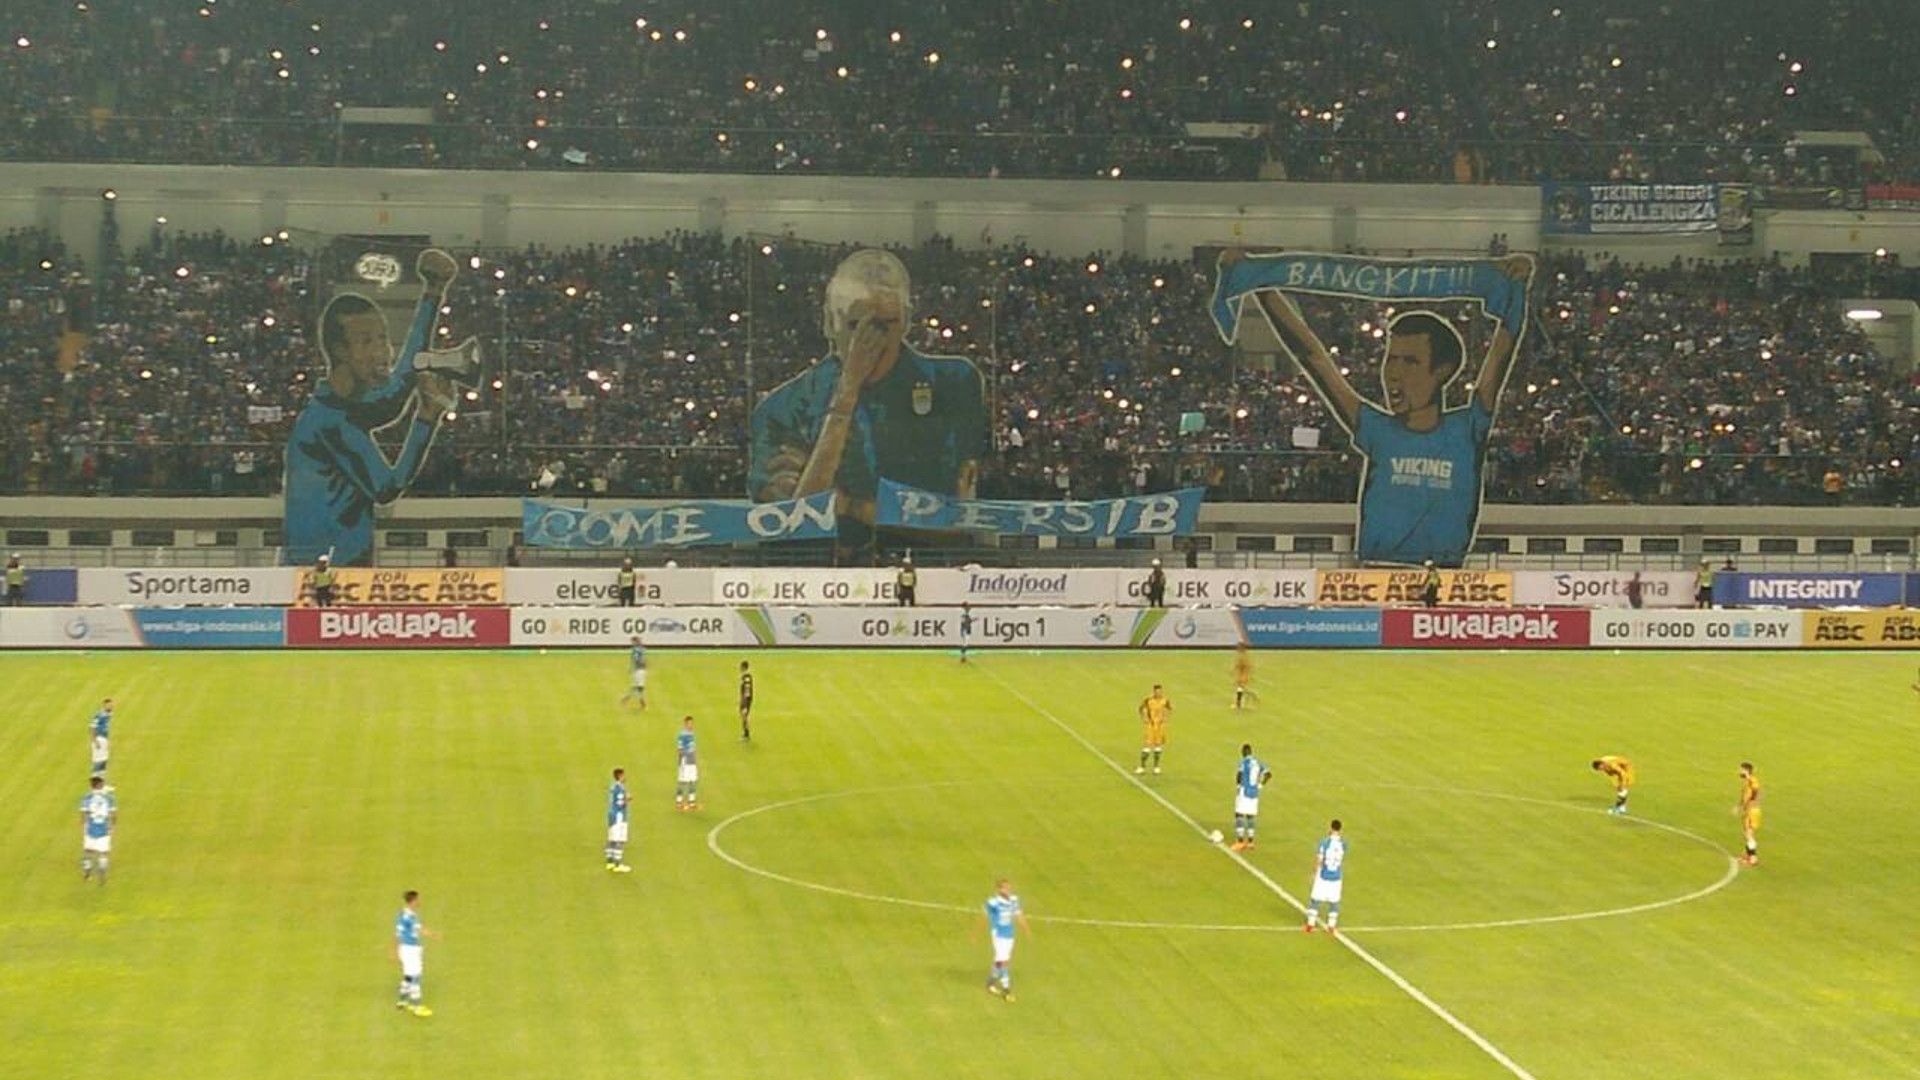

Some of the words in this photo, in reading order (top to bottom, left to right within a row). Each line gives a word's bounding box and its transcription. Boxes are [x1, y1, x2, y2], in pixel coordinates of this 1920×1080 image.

[1391, 458, 1453, 478] VIKING
[534, 509, 711, 547] COME
[748, 493, 836, 536] ON
[897, 490, 1179, 534] PERSIB
[126, 572, 250, 599] Sportama
[373, 571, 408, 583] KOPI
[441, 571, 475, 583] KOPI
[1325, 572, 1357, 583] KOPI
[1390, 572, 1423, 583] KOPI
[1453, 572, 1486, 583] KOPI
[298, 583, 361, 601] AC
[368, 583, 431, 602] ABC
[436, 583, 498, 602] ABC
[556, 578, 661, 599] eleveia
[722, 581, 750, 599] GO
[773, 581, 806, 599] JEK
[823, 581, 849, 599] GO
[968, 573, 1067, 600] Indofood
[1176, 581, 1209, 598] JEK
[1225, 581, 1250, 598] GO
[1273, 581, 1306, 598] JEK
[1320, 583, 1378, 601] ABC
[1385, 584, 1442, 601] AB
[1449, 583, 1507, 601] ABC
[1749, 579, 1863, 599] INTEGRITY
[522, 619, 546, 634] GO
[569, 619, 610, 634] RIDE
[623, 619, 646, 634] GO
[689, 618, 723, 633] CAR
[862, 620, 889, 636] GO
[912, 620, 946, 636] JEK
[983, 617, 1029, 642] Liga
[1036, 617, 1045, 636] 1
[1247, 621, 1378, 634] www.liga-indonesia.id
[1606, 622, 1630, 638] GO
[1646, 622, 1694, 638] FOOD
[1707, 622, 1730, 638] GO
[1755, 622, 1790, 638] PAY
[1815, 625, 1865, 641] ABC
[1881, 625, 1920, 641] AB
